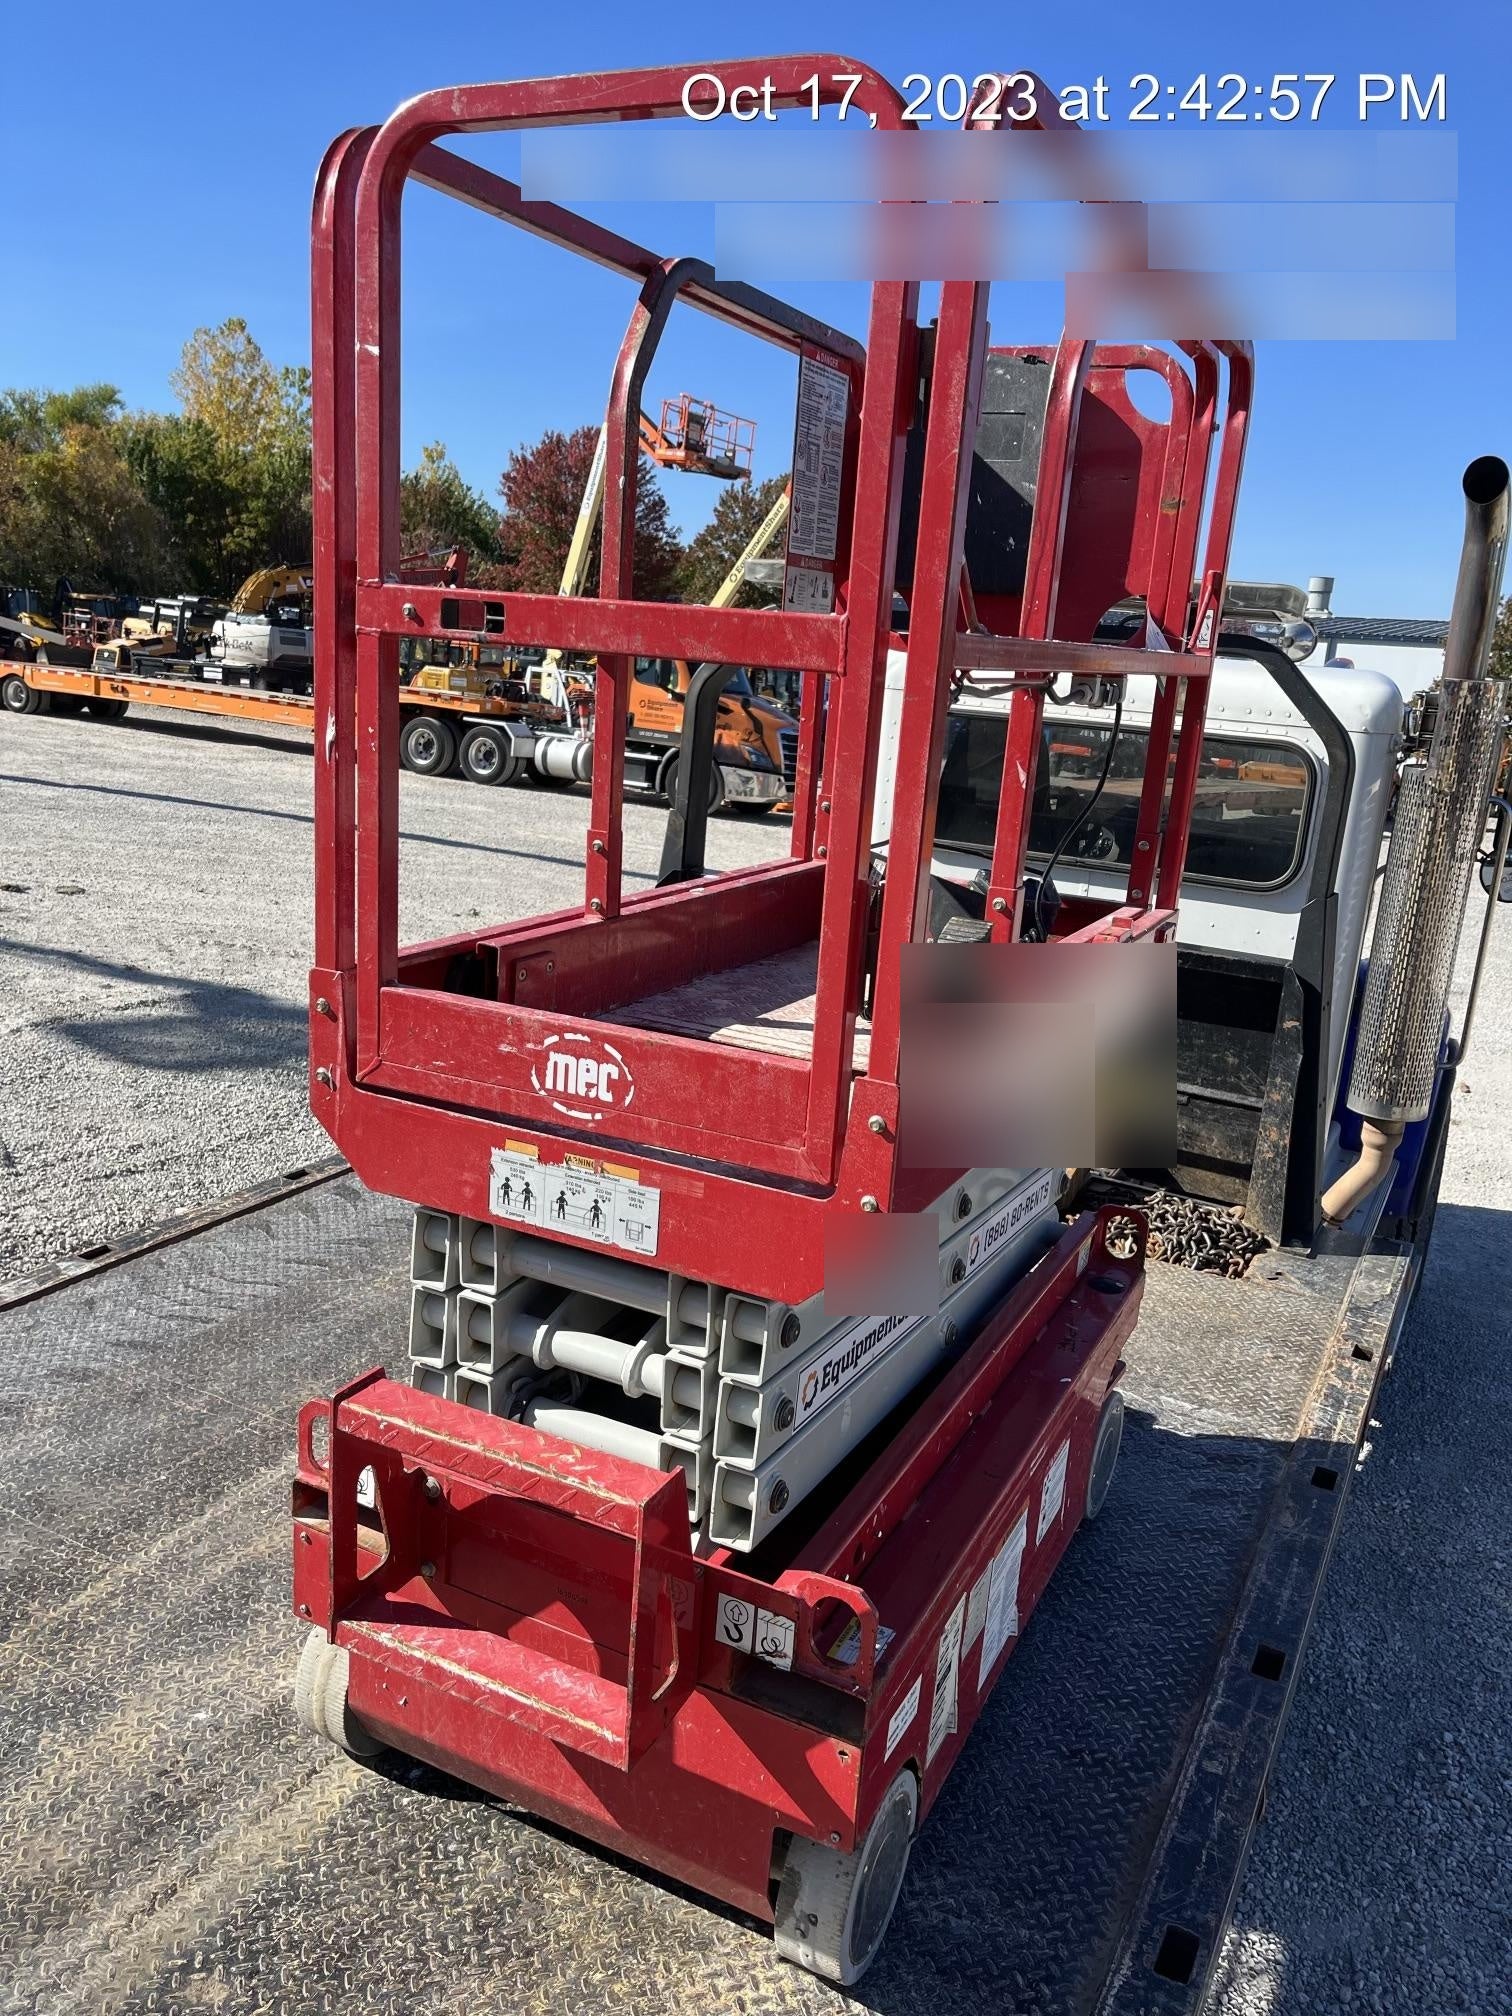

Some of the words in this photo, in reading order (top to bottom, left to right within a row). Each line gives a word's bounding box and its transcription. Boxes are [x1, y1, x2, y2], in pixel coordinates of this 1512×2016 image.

[735, 503, 785, 573] EqipmentShare
[984, 1212, 1009, 1252] (888)
[1011, 1181, 1050, 1227] 80-RENTS
[821, 1315, 908, 1392] Equipment
